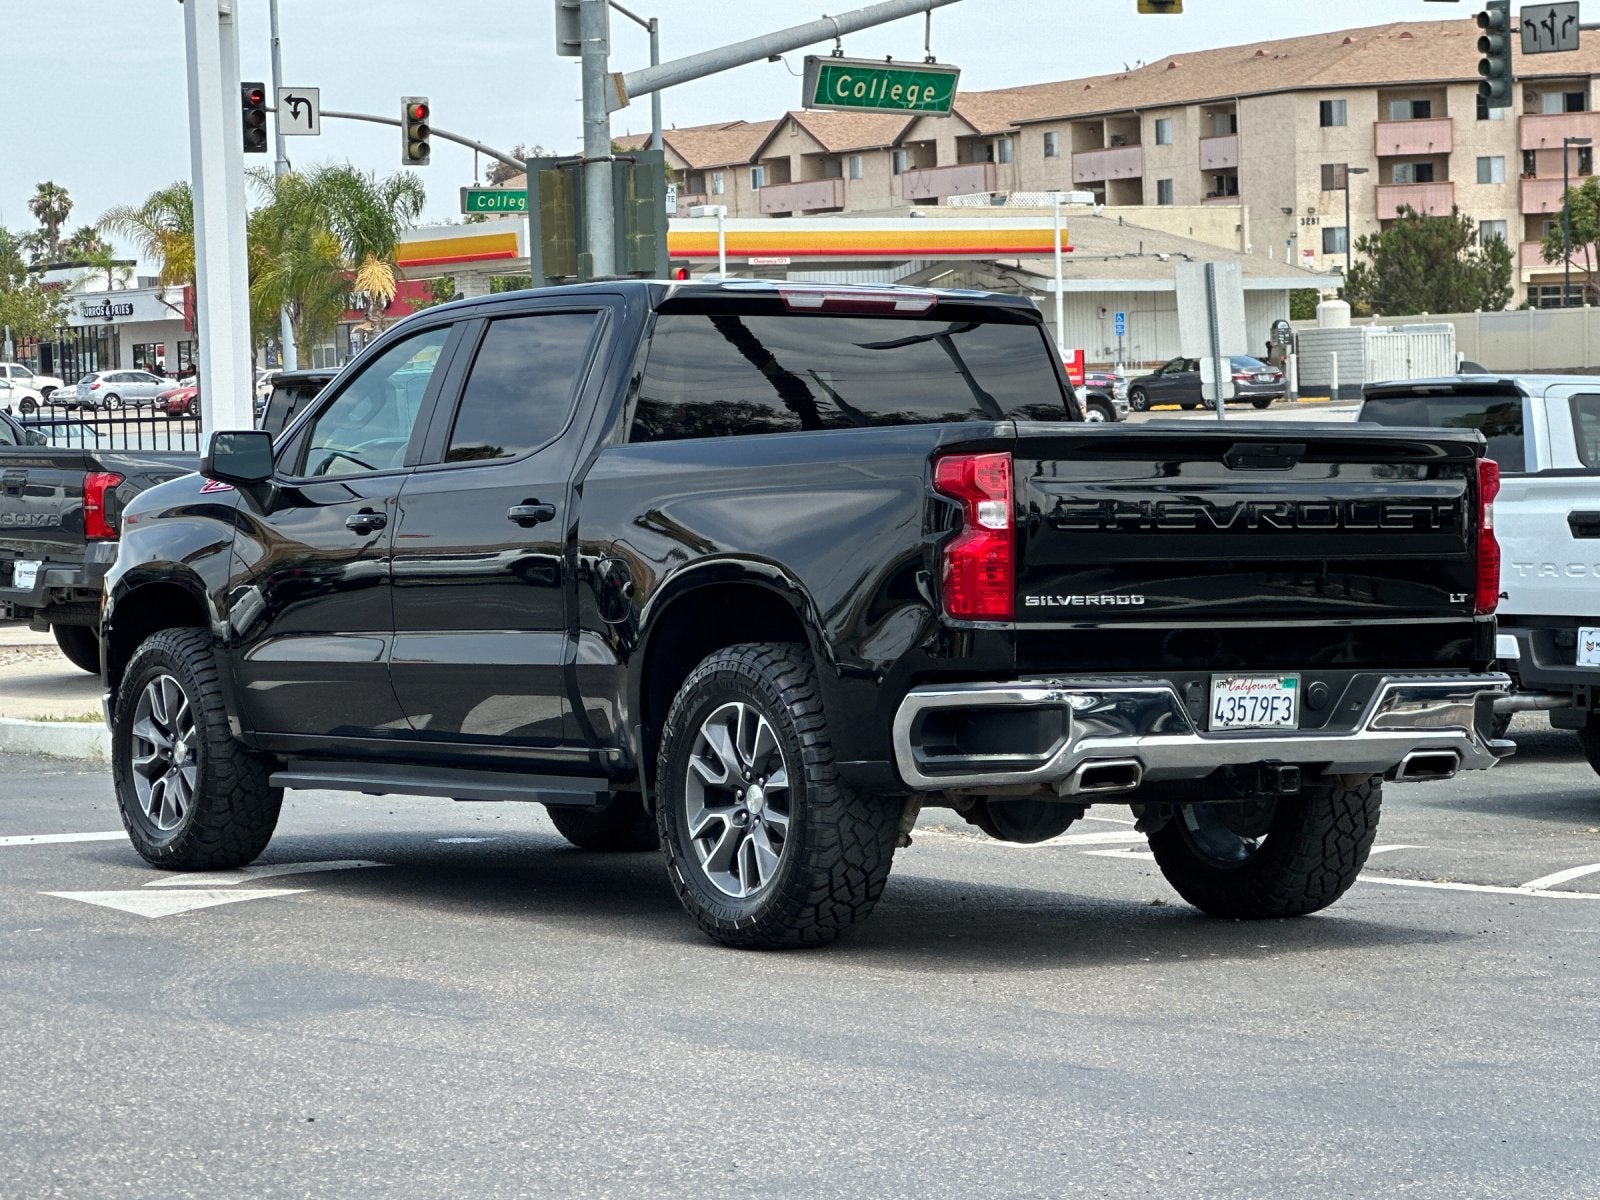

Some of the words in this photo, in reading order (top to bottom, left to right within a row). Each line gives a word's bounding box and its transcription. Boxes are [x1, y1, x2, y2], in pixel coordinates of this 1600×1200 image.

[836, 75, 935, 109] College
[477, 195, 525, 210] Colleg
[111, 304, 130, 315] FRIES
[1057, 501, 1454, 529] CHEVROLET
[1025, 595, 1145, 606] SILVERADO
[1450, 593, 1468, 602] LT
[1228, 677, 1281, 695] California
[1215, 696, 1292, 722] 43579F3
